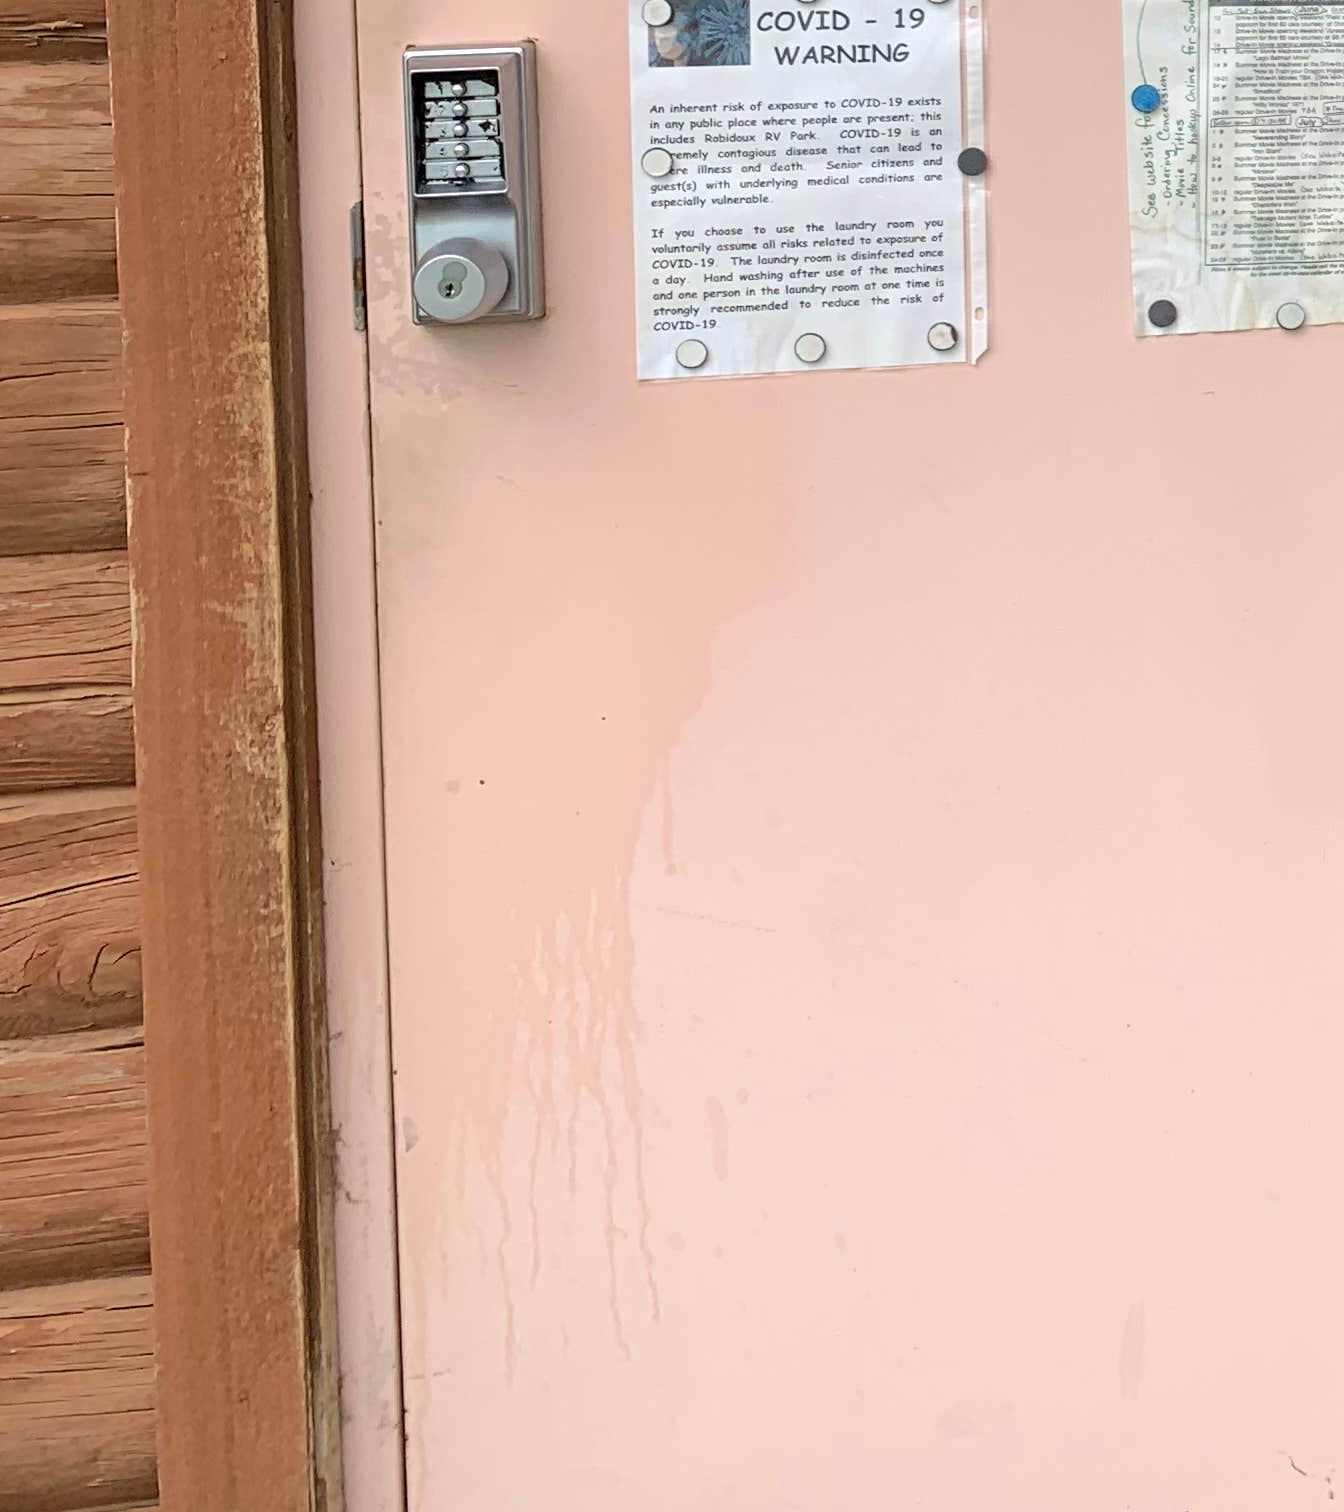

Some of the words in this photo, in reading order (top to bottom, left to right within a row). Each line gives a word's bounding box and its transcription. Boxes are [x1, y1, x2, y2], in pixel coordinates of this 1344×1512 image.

[756, 10, 851, 32] COVID
[894, 8, 926, 30] 19
[774, 44, 910, 66] WARNING
[649, 104, 665, 114] An
[670, 103, 717, 113] inherent
[723, 102, 745, 112] risk
[750, 101, 762, 111] of
[768, 100, 818, 114] exposure
[824, 100, 836, 109] to
[841, 97, 903, 109] COVID-19
[908, 97, 942, 107] exists
[650, 120, 660, 130] in
[665, 120, 686, 133] any
[690, 118, 723, 131] public
[728, 117, 757, 130] place
[762, 116, 797, 127] where
[802, 114, 837, 127] people
[843, 115, 862, 124] are
